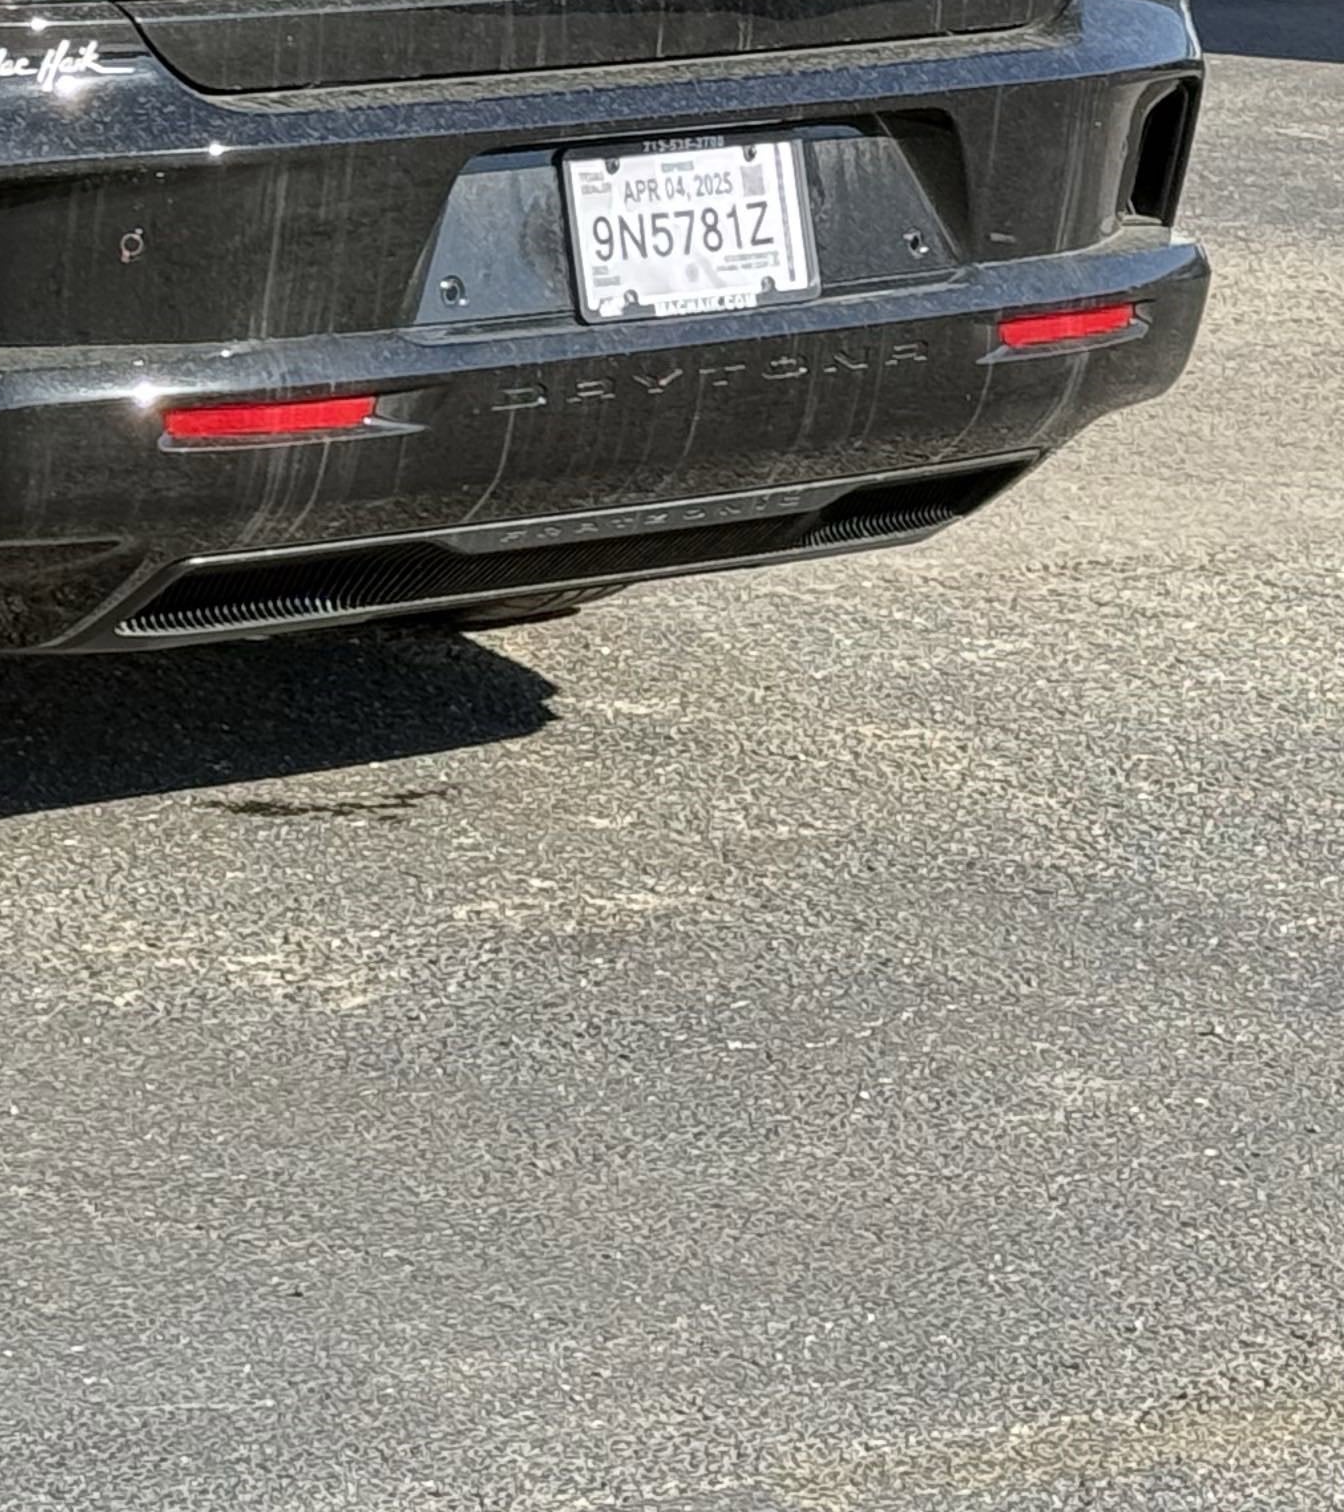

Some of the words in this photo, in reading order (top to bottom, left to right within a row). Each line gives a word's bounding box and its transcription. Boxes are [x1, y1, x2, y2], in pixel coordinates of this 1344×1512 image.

[623, 177, 661, 205] APR
[693, 170, 734, 198] 2025
[592, 200, 775, 263] 9N5781Z
[490, 339, 930, 413] DAYTONA
